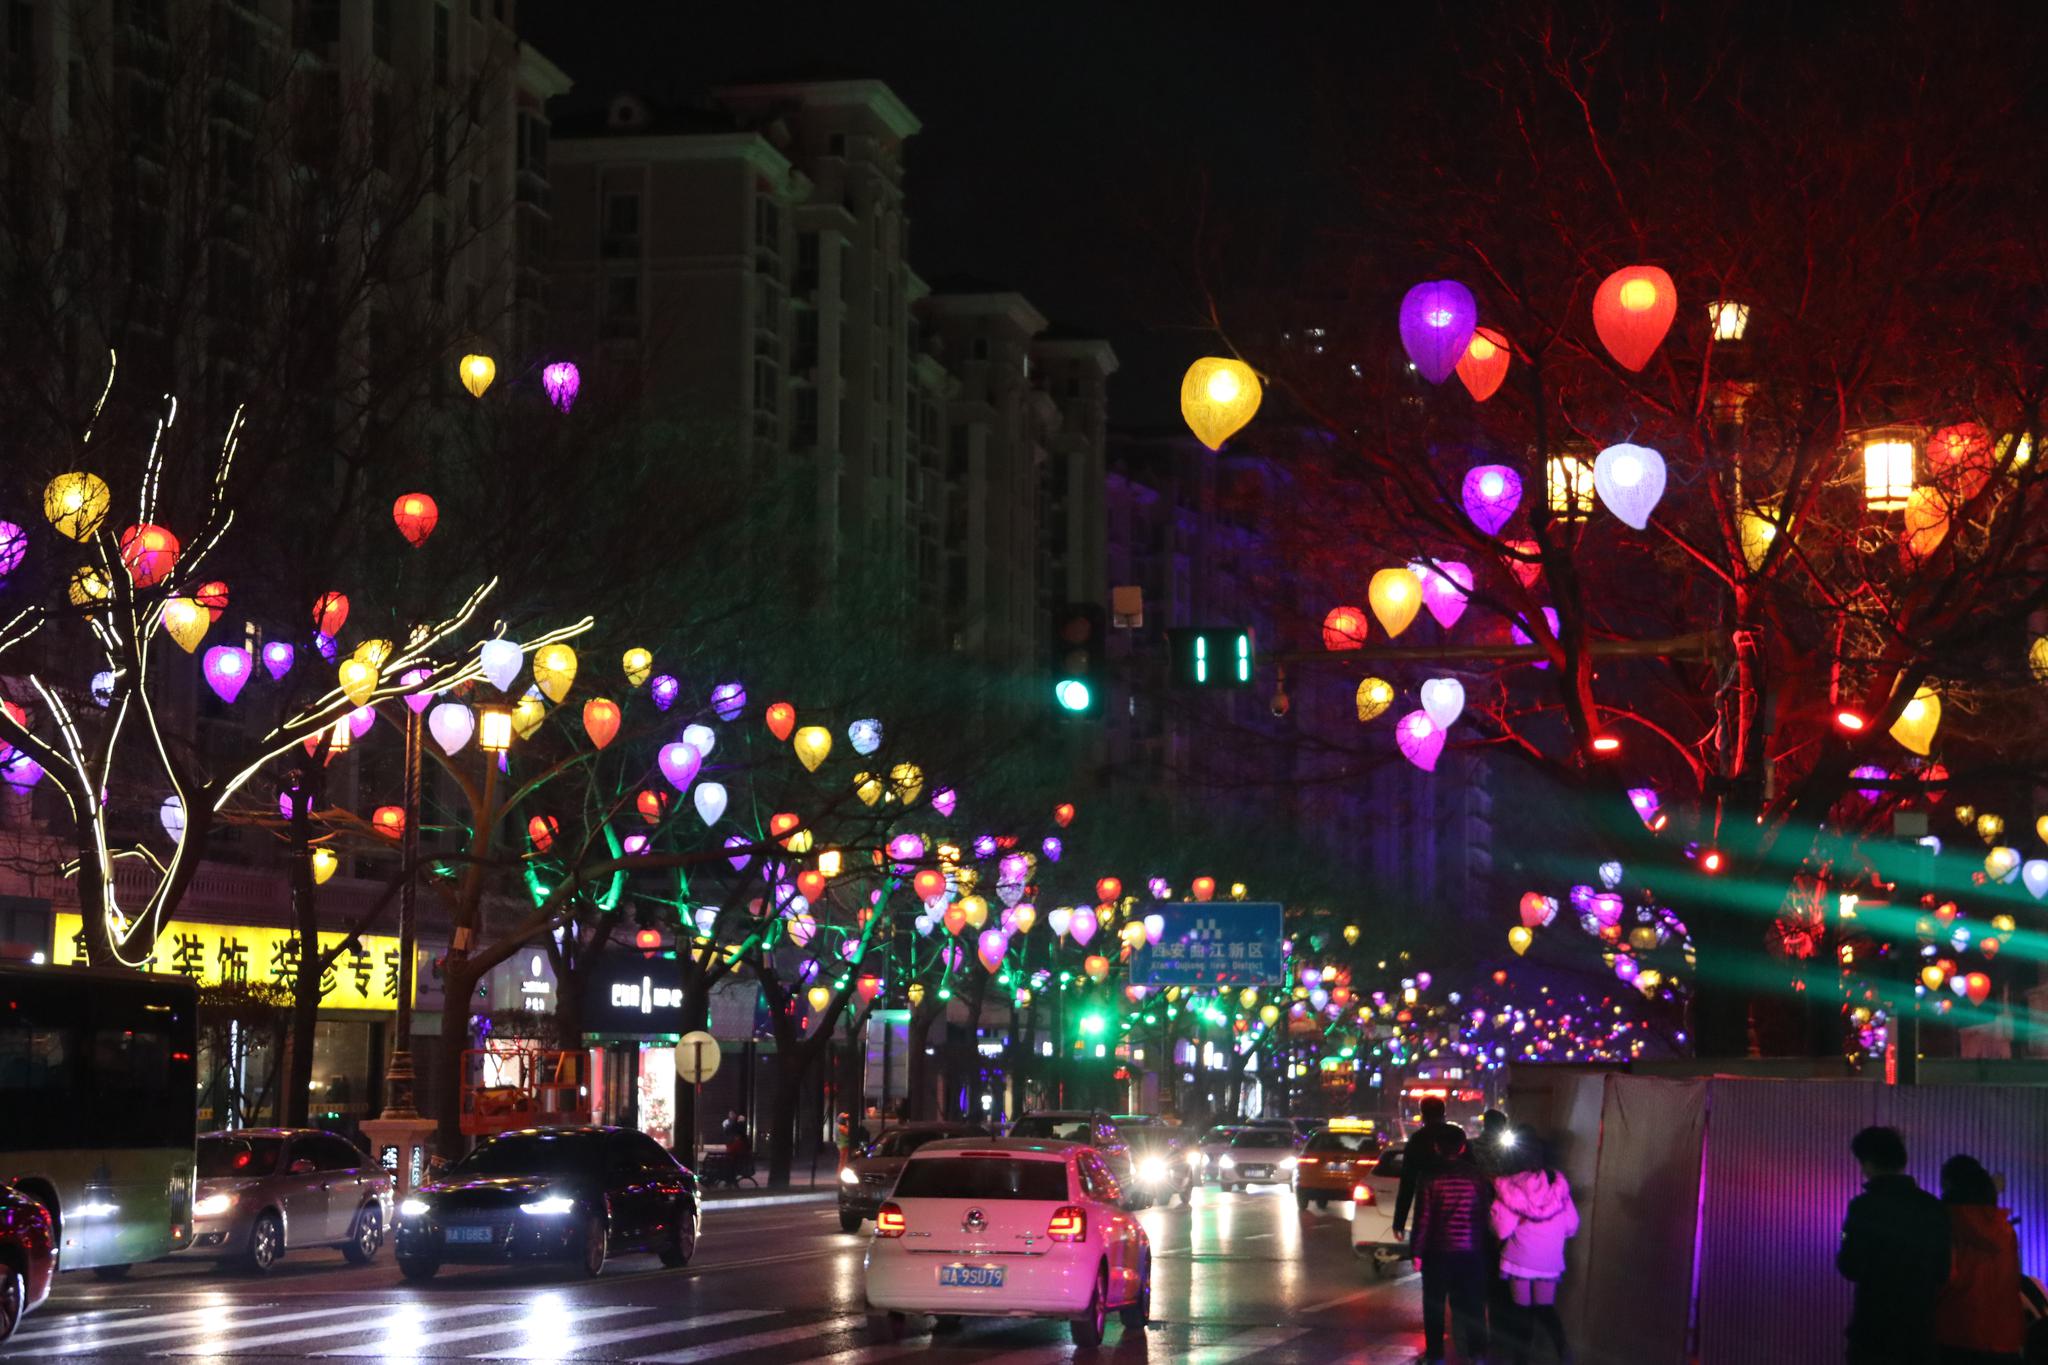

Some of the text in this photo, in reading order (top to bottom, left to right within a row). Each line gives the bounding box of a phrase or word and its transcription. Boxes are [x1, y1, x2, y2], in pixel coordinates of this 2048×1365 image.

[1196, 635, 1248, 682] 11
[1152, 942, 1264, 958] 西安曲江新区
